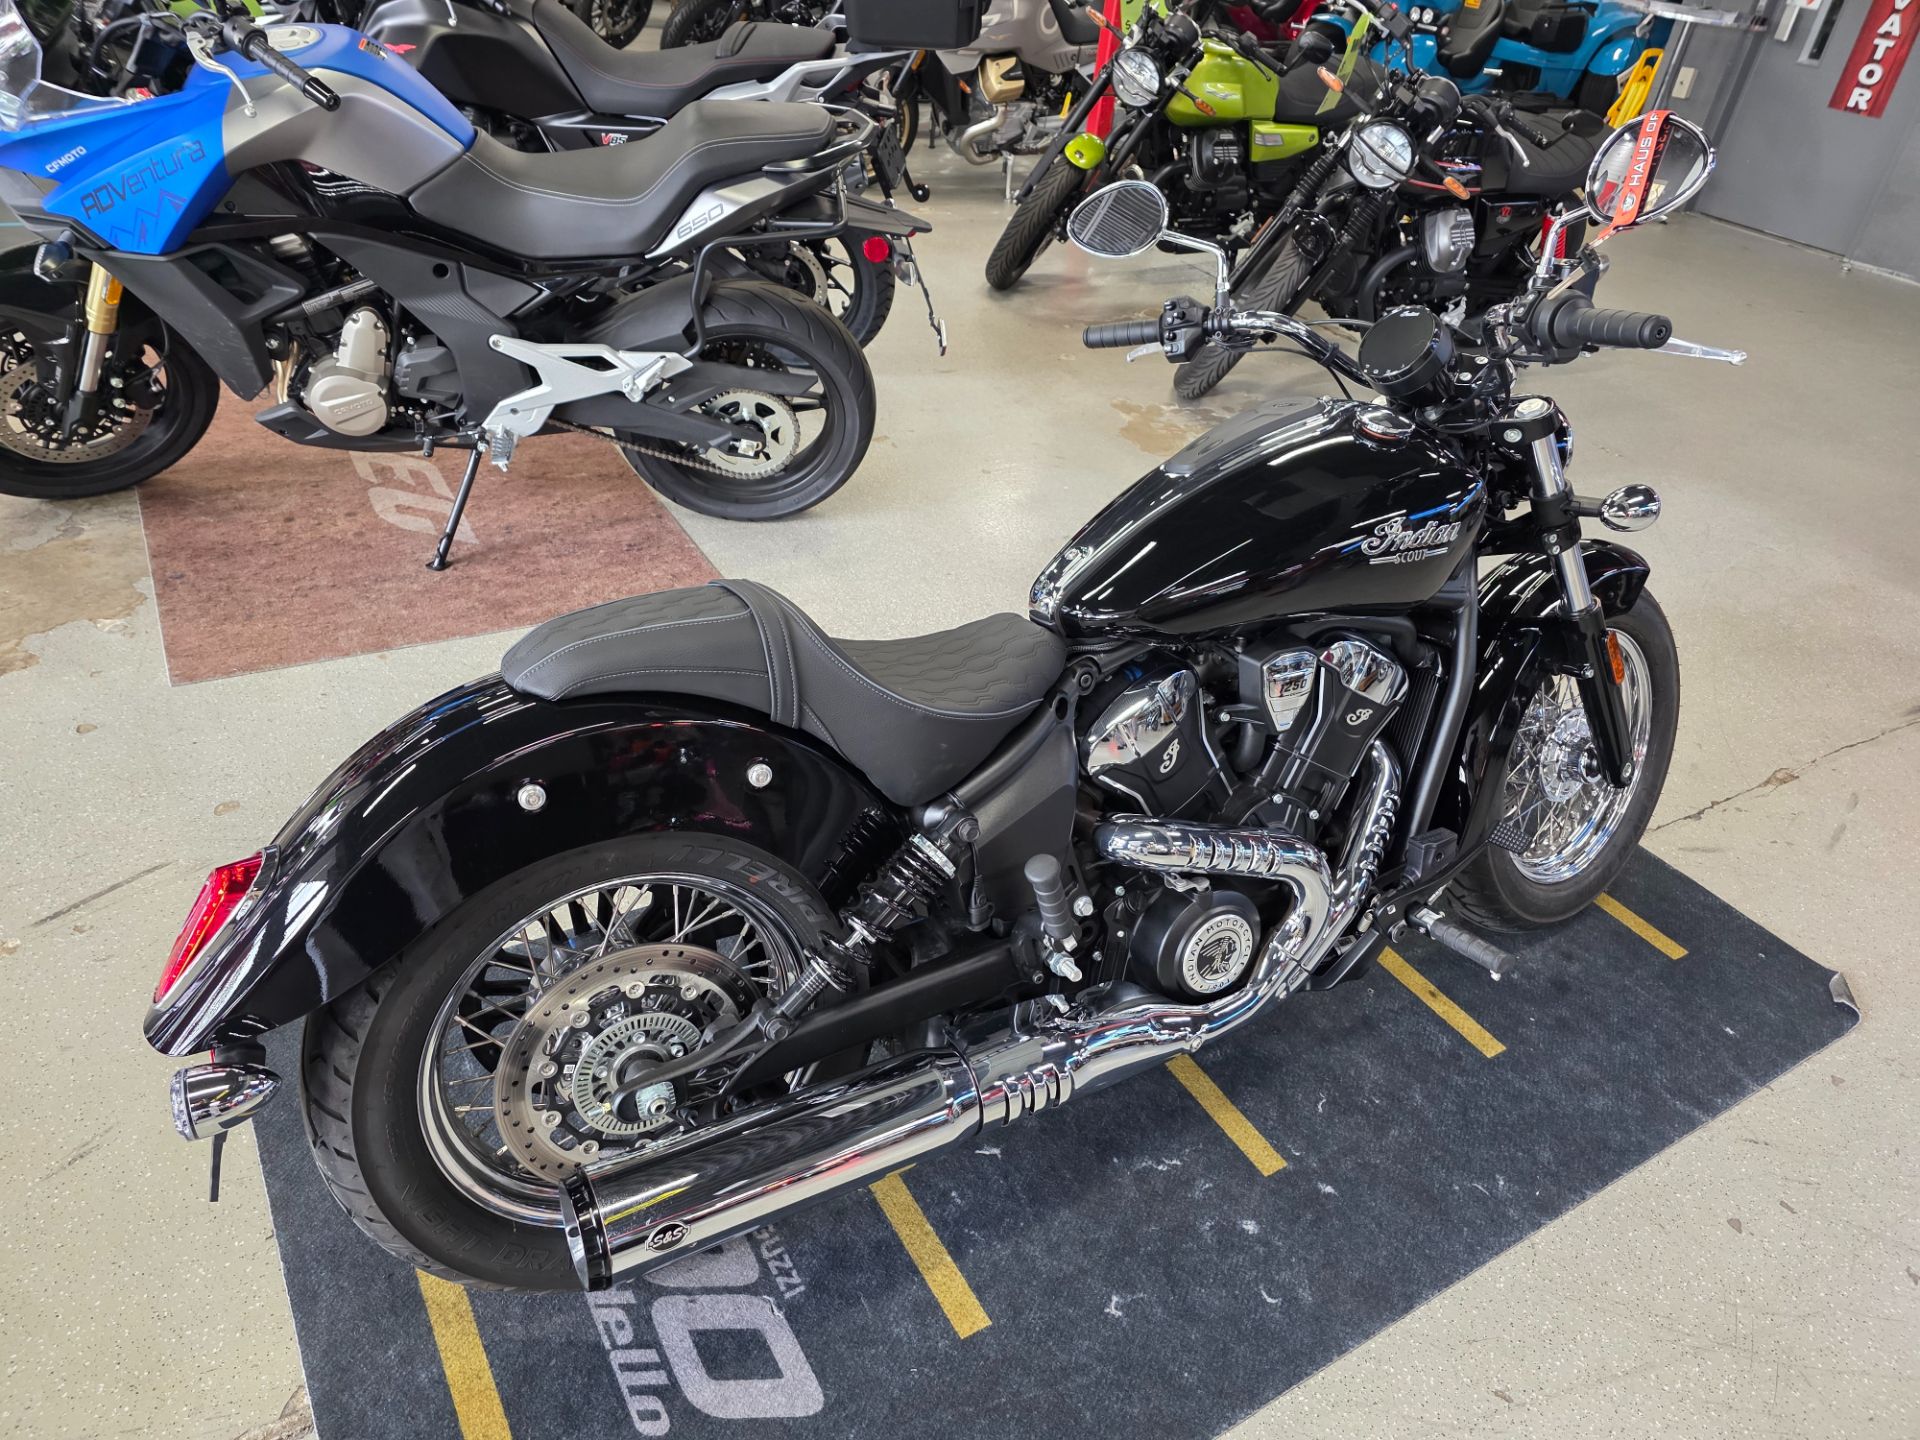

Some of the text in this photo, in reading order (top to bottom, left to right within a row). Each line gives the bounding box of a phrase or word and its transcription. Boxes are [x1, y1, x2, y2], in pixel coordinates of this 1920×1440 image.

[44, 145, 87, 174] CFMOTO
[1628, 136, 1652, 186] HAUS
[1645, 112, 1660, 133] OF
[80, 139, 207, 220] ADVentura
[676, 203, 725, 239] 650
[1360, 516, 1462, 556] Indian
[1394, 548, 1428, 565] SCOUT
[1280, 678, 1307, 694] 1250
[665, 844, 831, 924] PIRELLI
[1187, 937, 1204, 986] INDIAN
[652, 1226, 684, 1248] S&S
[491, 1241, 577, 1273] DRA
